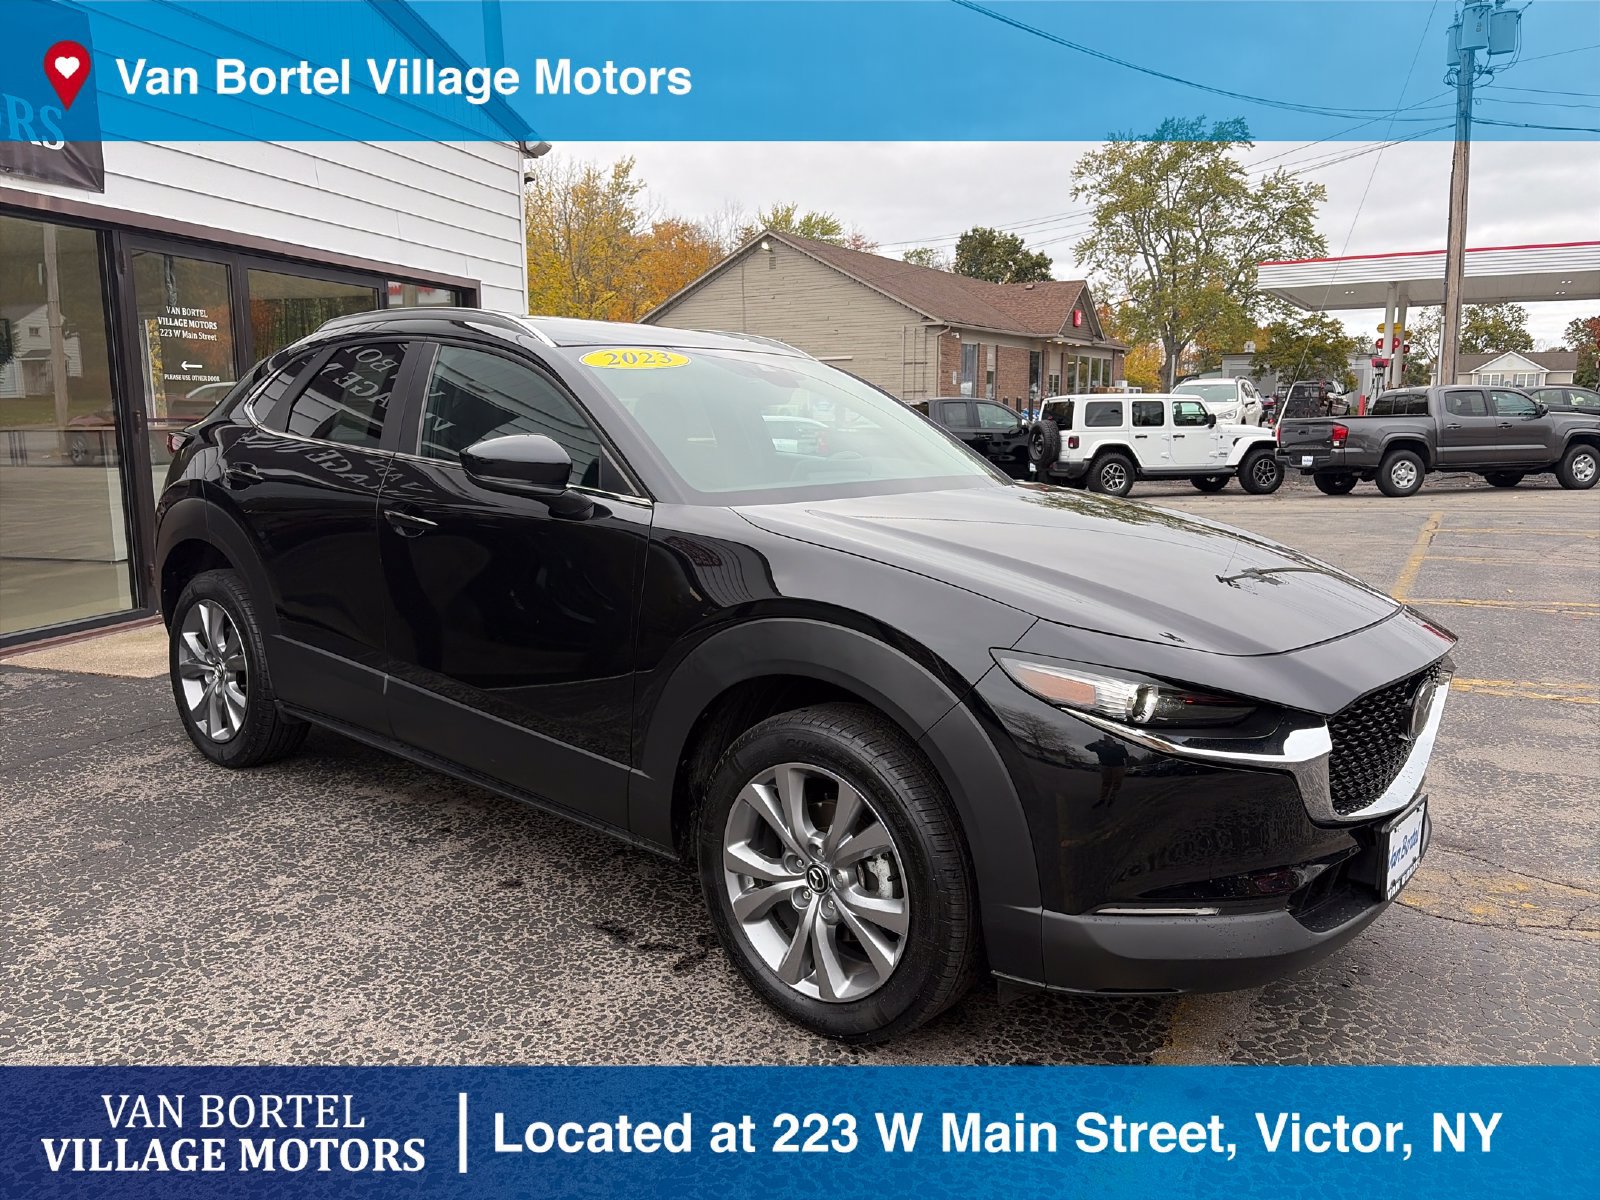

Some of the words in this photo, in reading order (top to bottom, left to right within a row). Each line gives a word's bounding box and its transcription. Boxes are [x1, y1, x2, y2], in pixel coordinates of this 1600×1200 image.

[166, 306, 180, 315] VAN
[182, 307, 208, 318] BORTEL
[157, 316, 188, 328] VILLAGE
[188, 319, 218, 330] MOTORS
[160, 328, 173, 338] 223
[173, 329, 181, 338] W
[182, 330, 198, 340] Main
[199, 332, 218, 341] Street
[604, 352, 672, 366] 2023
[164, 373, 182, 381] PLEASE
